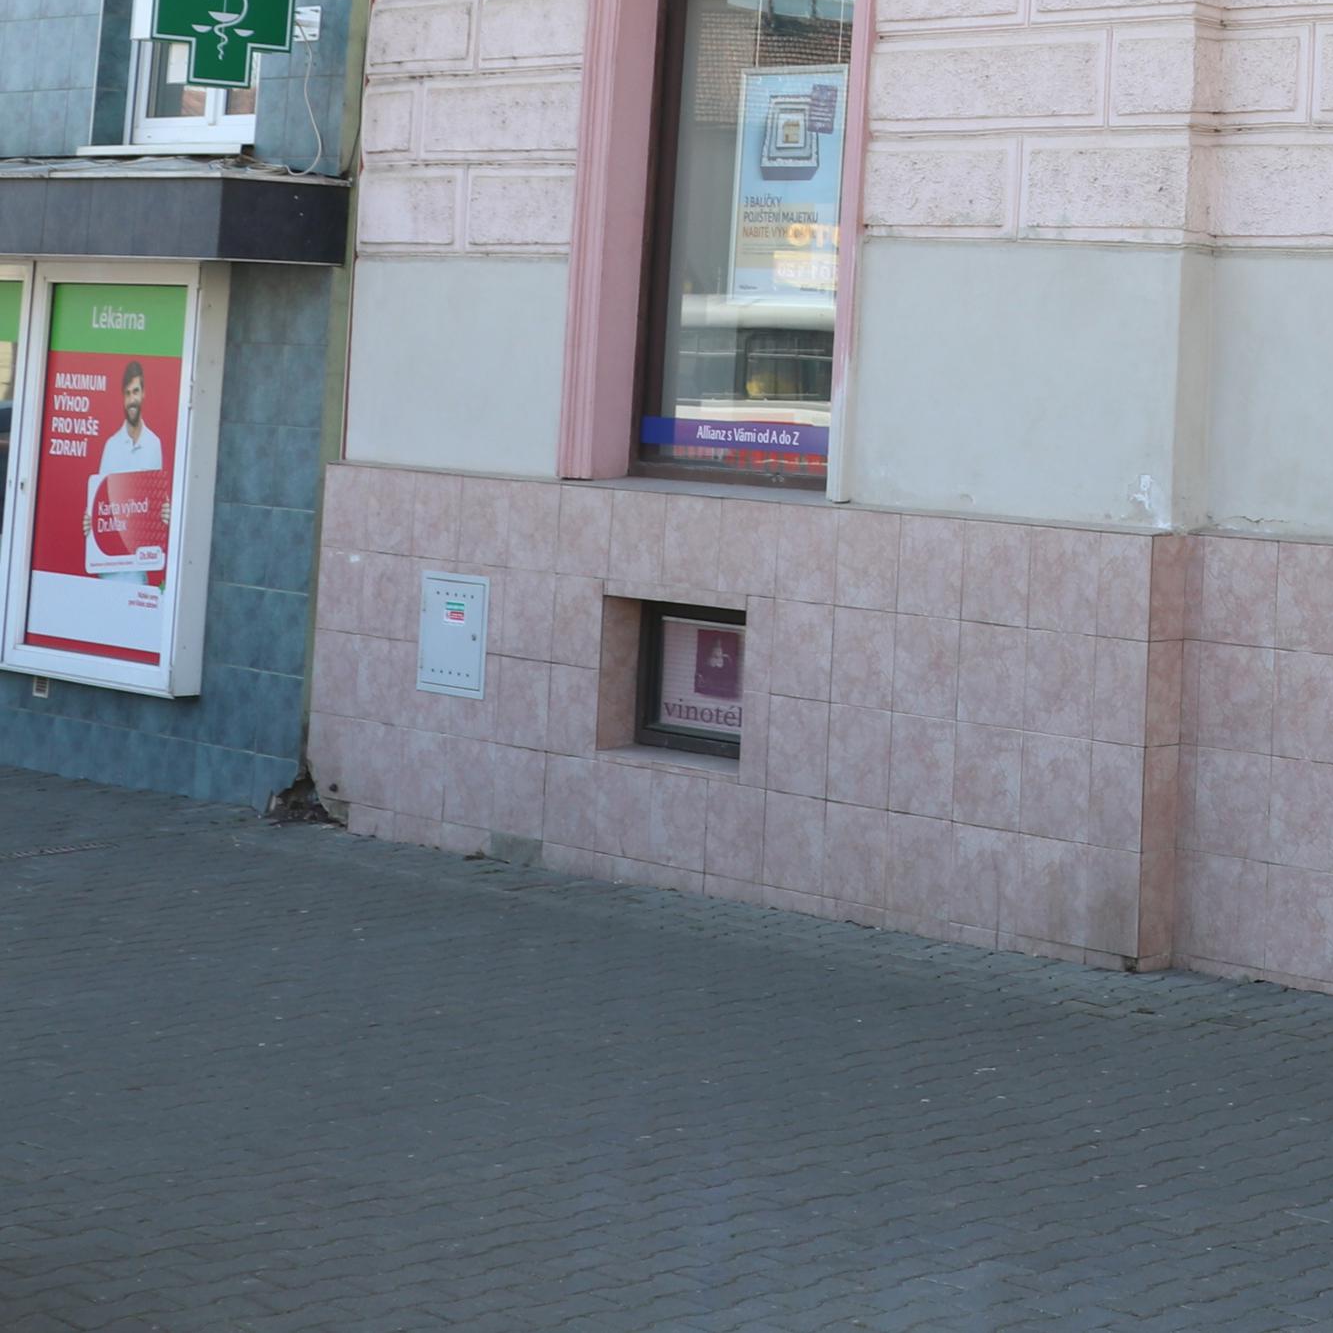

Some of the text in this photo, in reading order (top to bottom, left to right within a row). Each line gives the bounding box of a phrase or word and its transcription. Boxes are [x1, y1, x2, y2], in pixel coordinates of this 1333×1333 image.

[782, 211, 818, 223] MAJETKU
[92, 305, 145, 330] Lékárna
[55, 372, 107, 391] MAXIMUM
[53, 392, 90, 413] VÝHOD
[51, 416, 99, 436] PRO VAŠE
[696, 425, 800, 446] Allianz s Vámi od A do Z
[49, 438, 88, 457] ZDRAVÍ
[98, 497, 148, 516] Karta výhod
